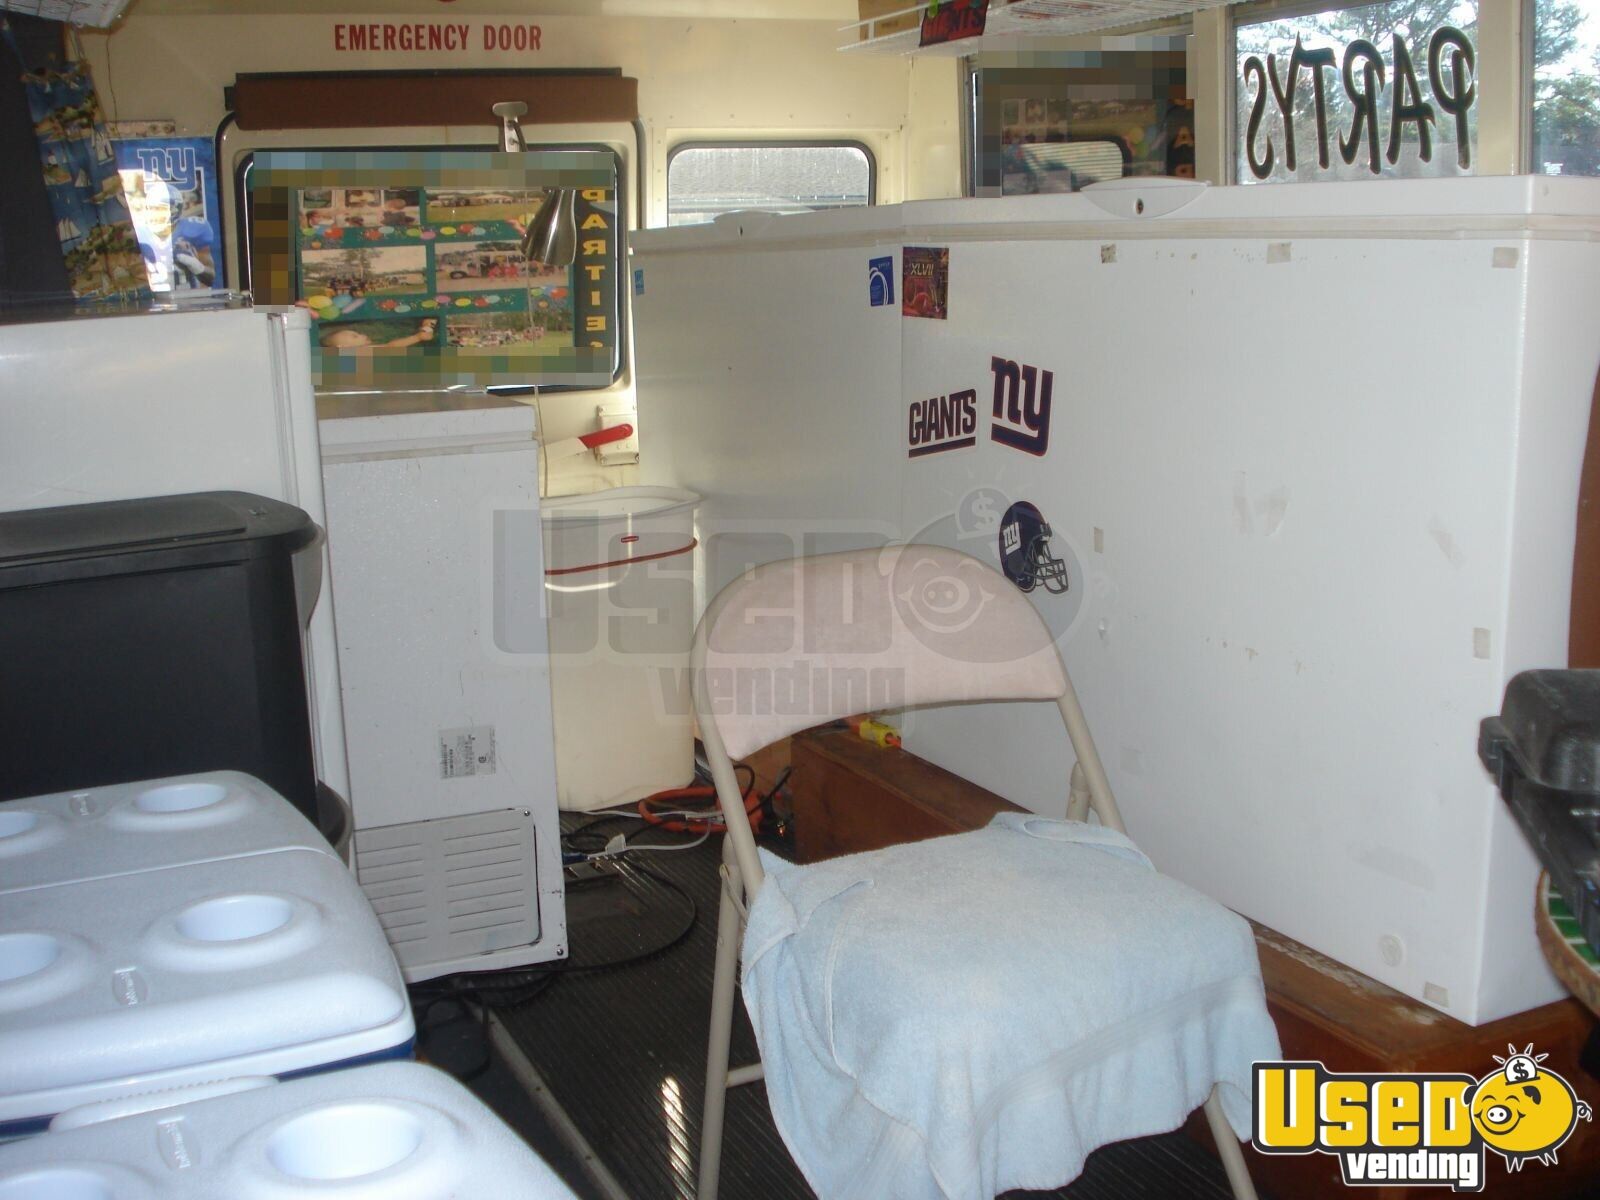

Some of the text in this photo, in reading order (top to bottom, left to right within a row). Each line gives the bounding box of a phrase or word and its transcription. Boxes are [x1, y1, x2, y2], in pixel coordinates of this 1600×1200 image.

[334, 24, 542, 51] EMERGENCY DOOR
[908, 388, 977, 447] GIANTS
